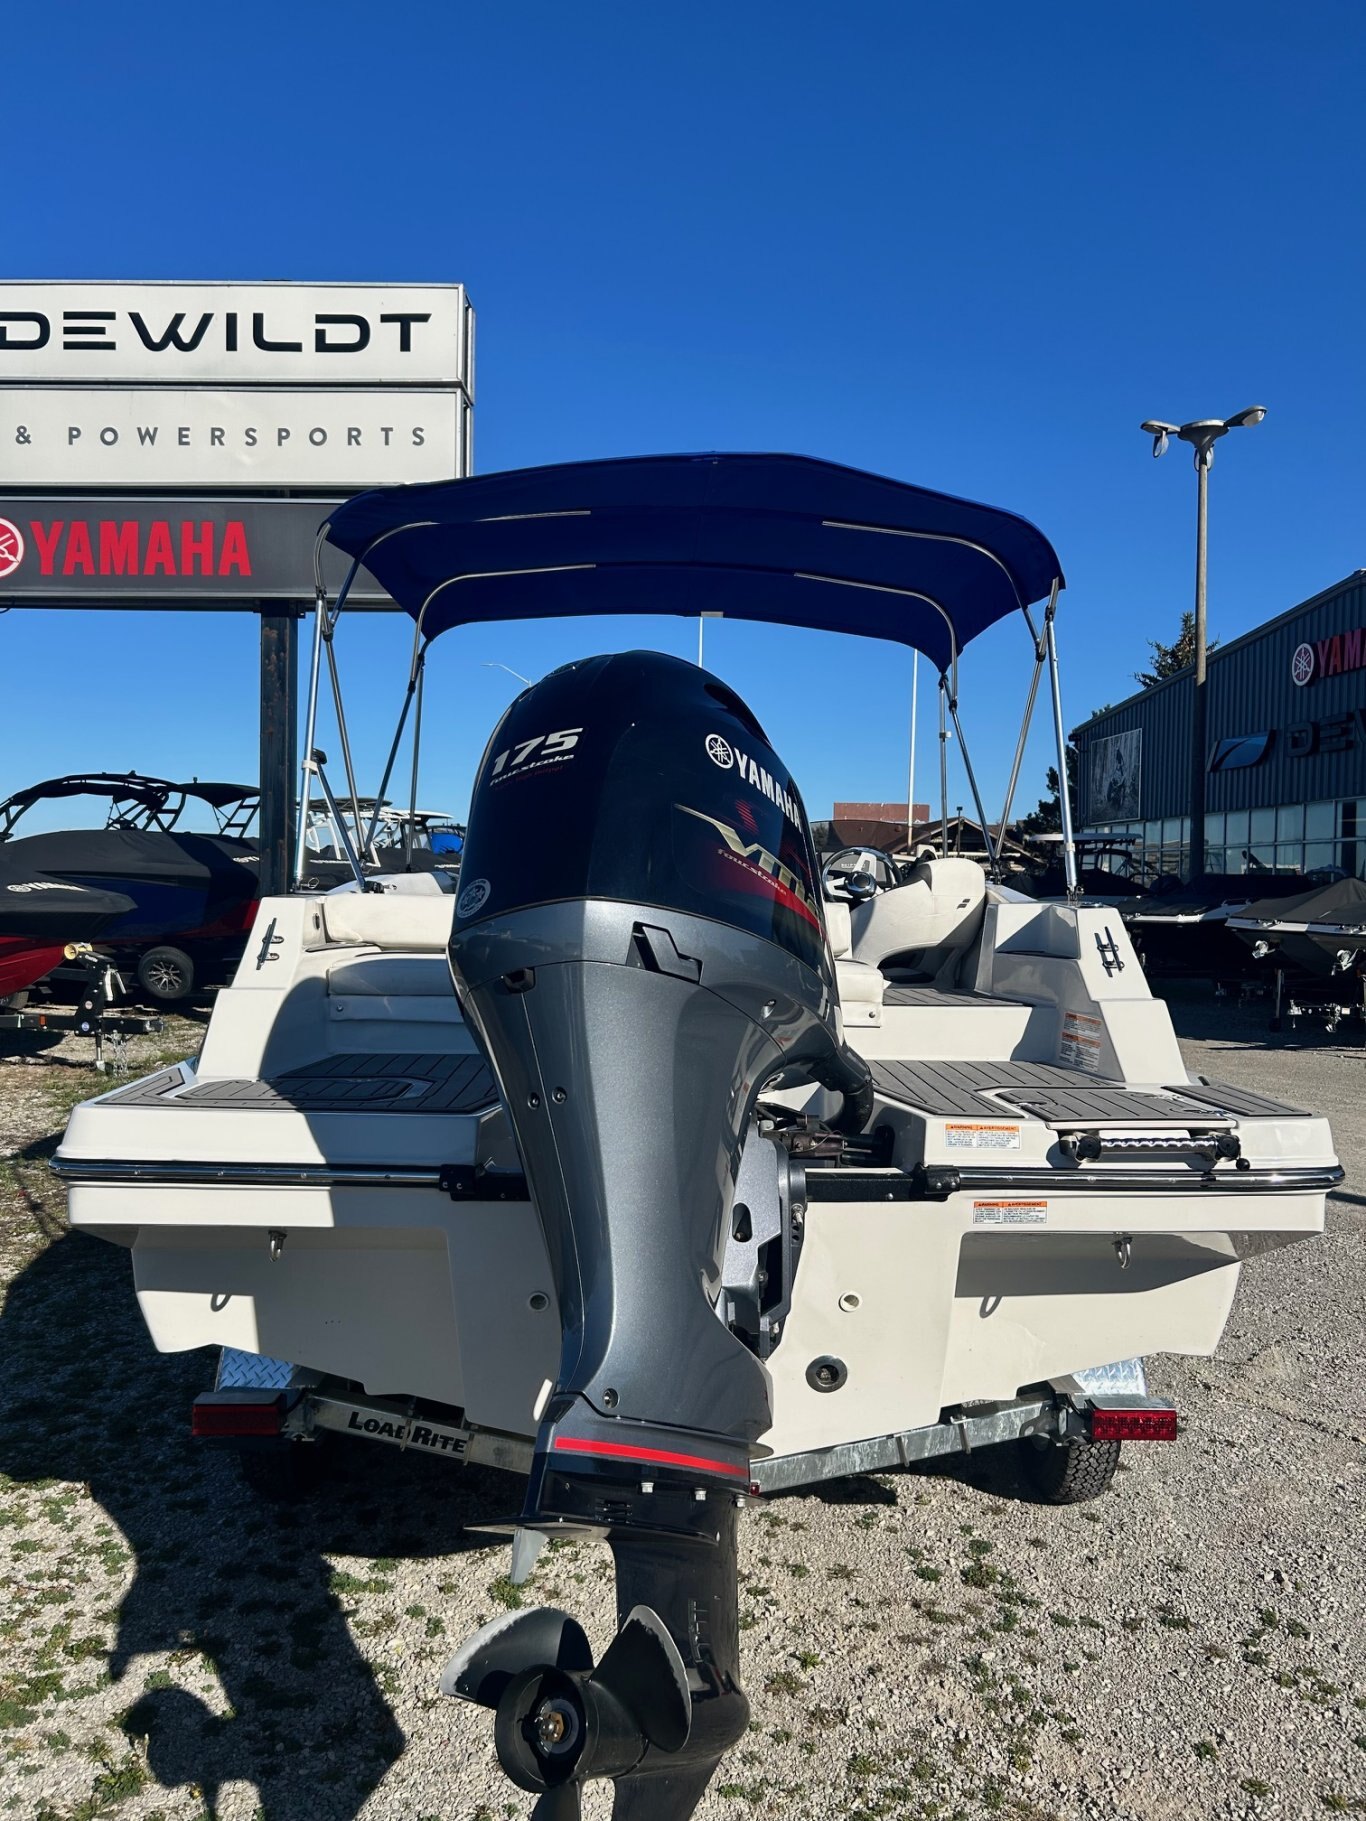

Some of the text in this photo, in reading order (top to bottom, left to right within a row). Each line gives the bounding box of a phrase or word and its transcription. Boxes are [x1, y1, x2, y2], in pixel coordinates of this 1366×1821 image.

[0, 311, 432, 353] DEWILDT
[15, 425, 426, 447] & POWERSPORTS
[30, 520, 252, 576] YAMAHA
[1317, 627, 1366, 678] YAM
[492, 727, 584, 776] 175
[733, 747, 802, 834] YAMAHA
